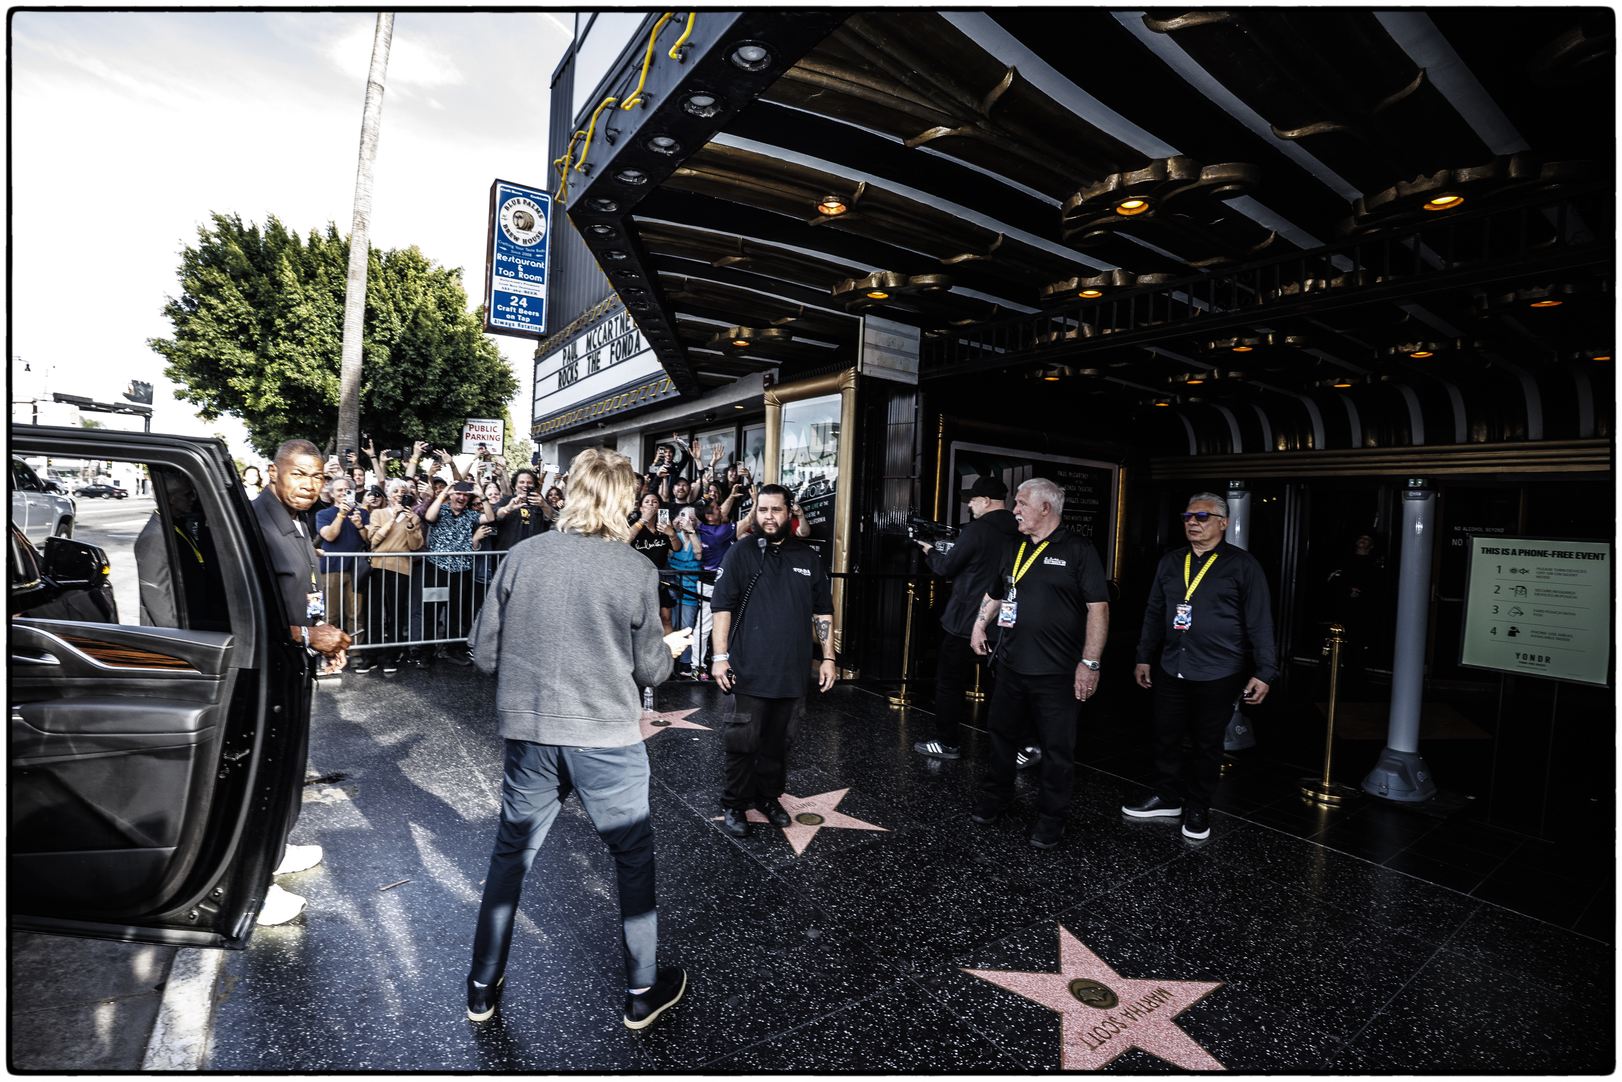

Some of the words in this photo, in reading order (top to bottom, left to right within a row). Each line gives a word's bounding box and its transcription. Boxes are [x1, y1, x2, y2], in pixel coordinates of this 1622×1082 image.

[504, 199, 521, 211] BLUE
[523, 199, 544, 219] PALMS
[503, 224, 520, 242] BREW
[522, 231, 543, 245] HOUSE
[498, 240, 514, 249] Crafting
[497, 253, 545, 269] Restaurant
[498, 267, 515, 278] Tap
[519, 271, 542, 282] Room
[510, 296, 528, 308] 24
[497, 305, 517, 314] Craft
[518, 308, 540, 318] Beers
[494, 319, 515, 327] Always
[518, 322, 542, 332] Rotating
[517, 315, 530, 323] Tap
[562, 340, 578, 366] PAUL
[586, 310, 632, 352] MCCARTNE
[558, 362, 578, 389] ROCKS
[587, 350, 601, 375] THE
[610, 328, 641, 364] FONDA
[469, 424, 498, 432] PUBLIC
[465, 432, 500, 441] PARKING
[1481, 547, 1500, 555] THIS
[1518, 549, 1574, 559] PHONE-FREE
[1575, 552, 1606, 560] EVENT
[1496, 565, 1501, 574] 1
[1494, 585, 1500, 594] 2
[1492, 605, 1499, 614] 3
[1490, 627, 1497, 635] 4
[1515, 652, 1551, 664] YONDR
[1120, 987, 1174, 1021] MARTHA
[1080, 1016, 1127, 1051] SCOTT
